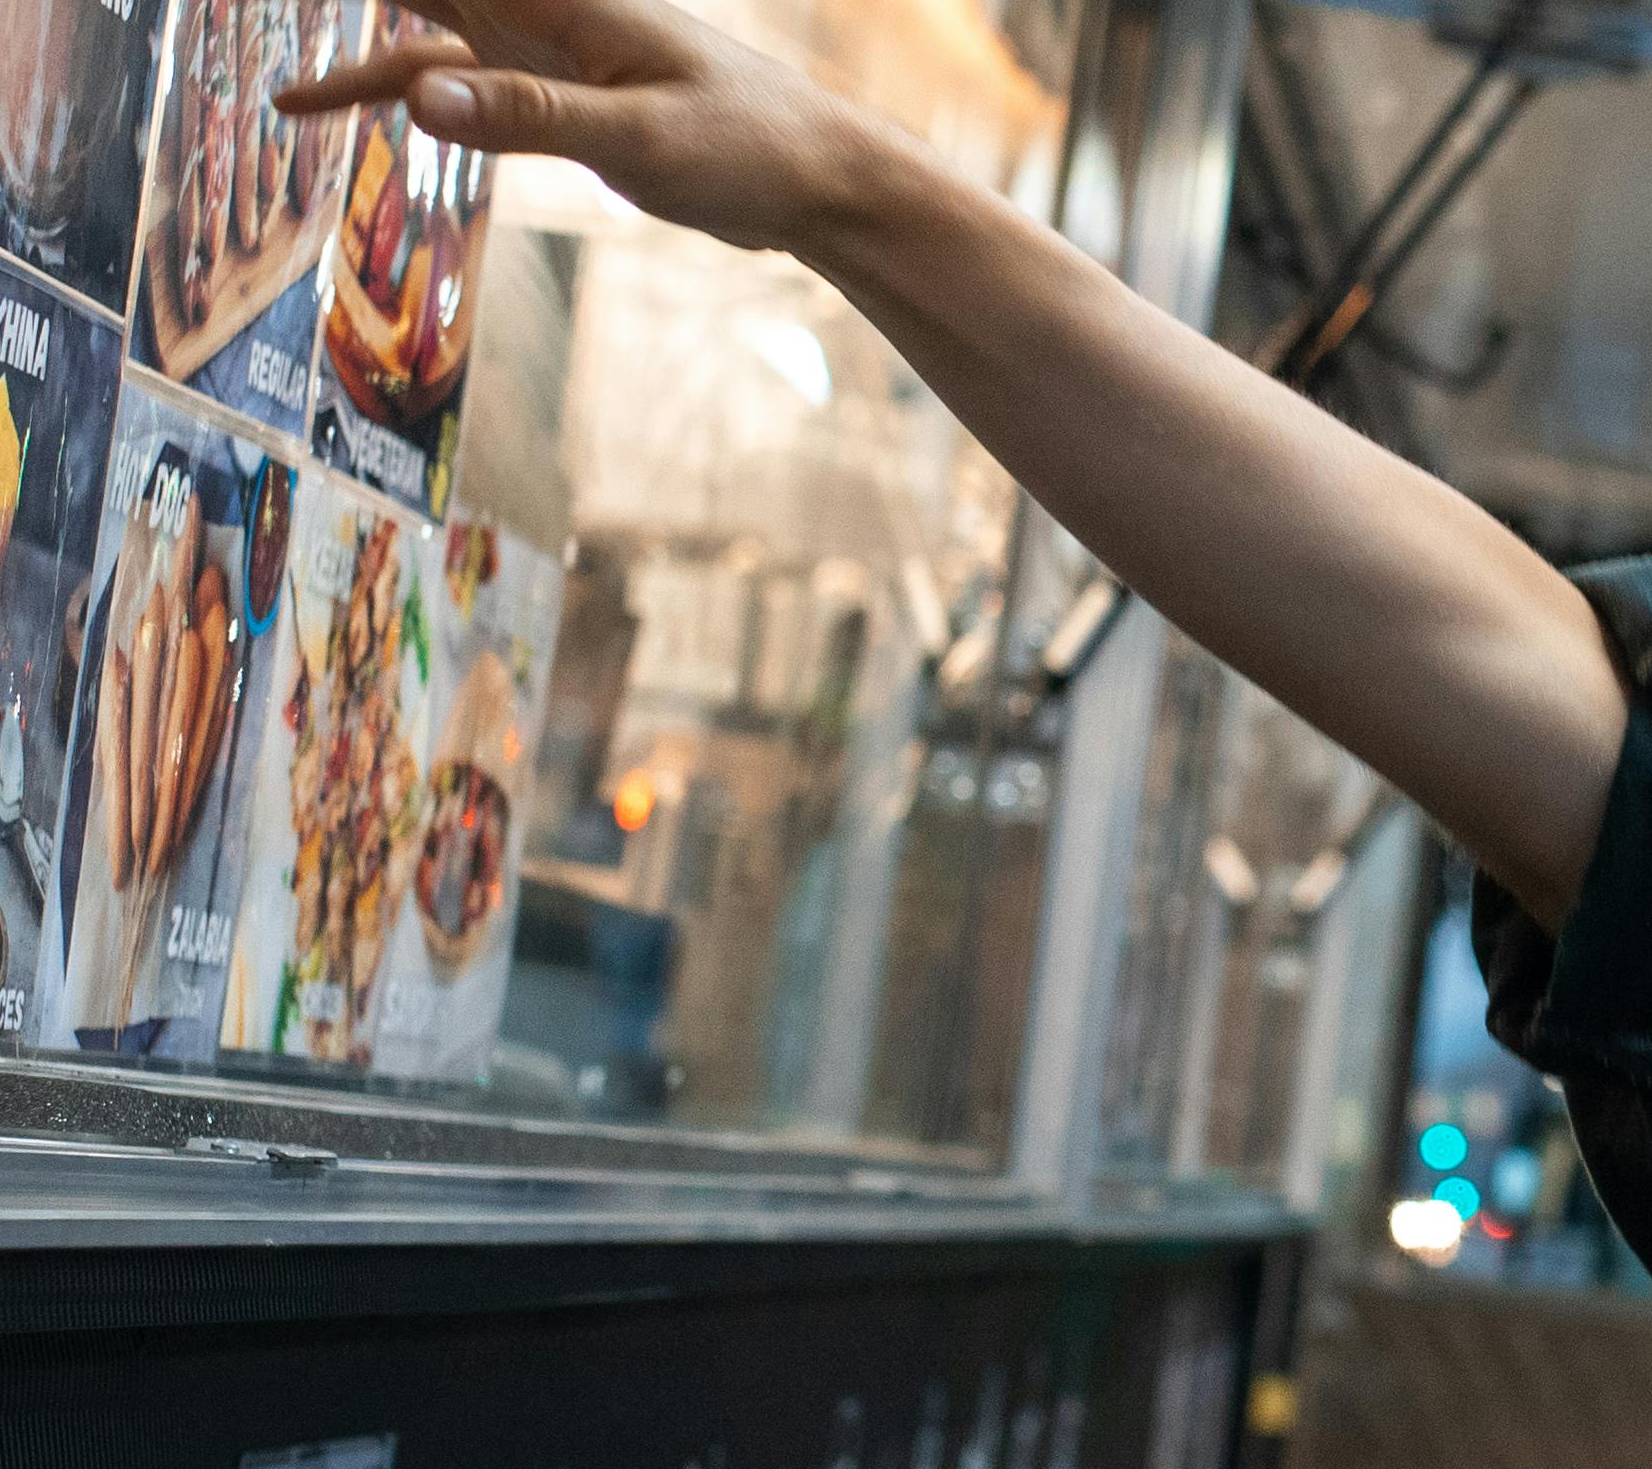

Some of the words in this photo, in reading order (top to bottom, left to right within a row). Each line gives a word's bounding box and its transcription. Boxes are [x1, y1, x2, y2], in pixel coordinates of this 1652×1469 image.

[249, 339, 307, 411] REGULAR
[109, 440, 152, 523] HOT
[149, 462, 192, 540] DOG
[167, 906, 233, 964] ZALABIA
